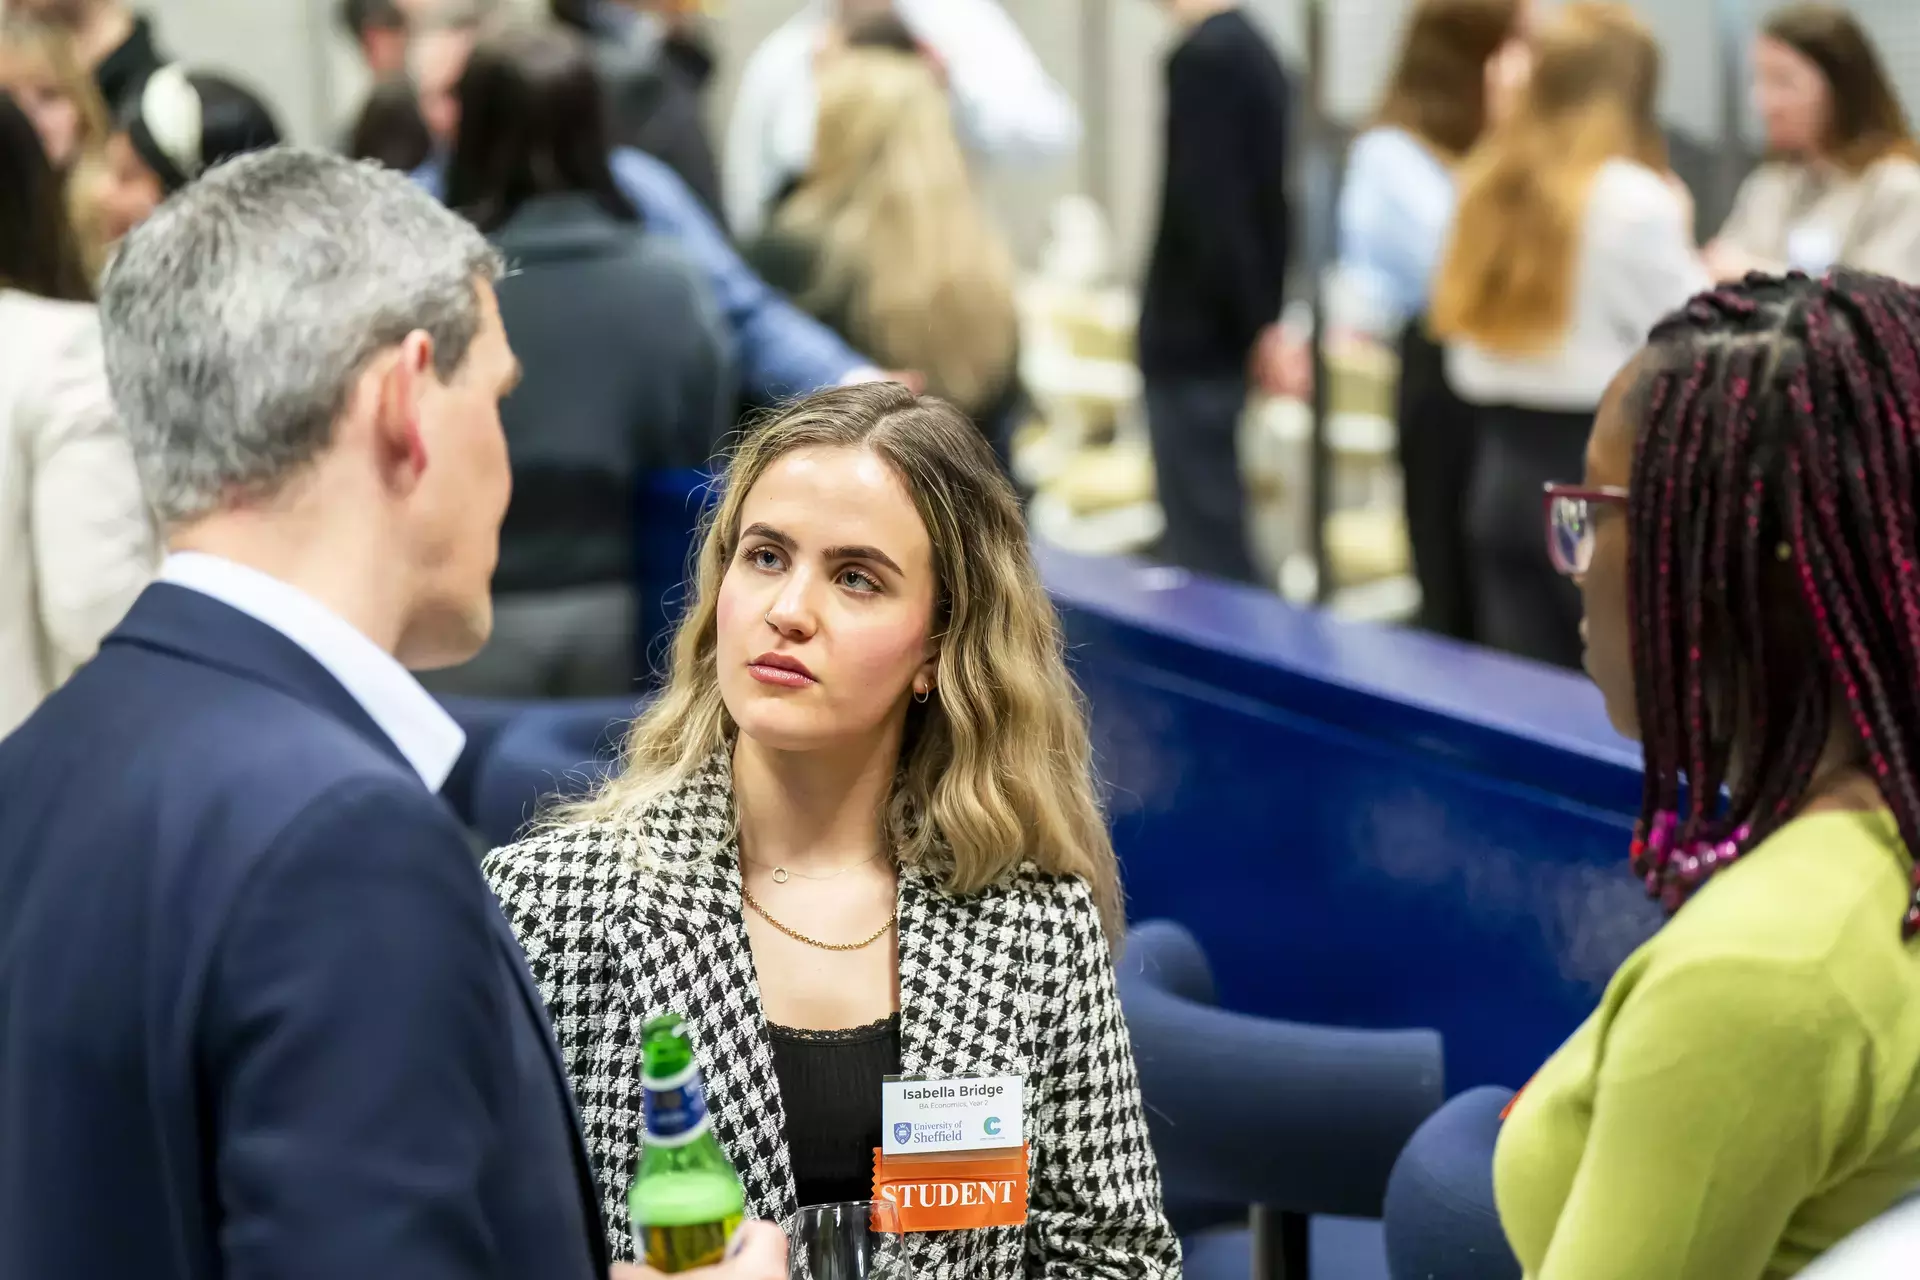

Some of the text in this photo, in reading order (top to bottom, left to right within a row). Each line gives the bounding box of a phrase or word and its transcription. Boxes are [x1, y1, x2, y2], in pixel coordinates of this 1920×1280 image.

[903, 1084, 1004, 1100] Isabella Bridge
[930, 1101, 969, 1109] Economics,
[914, 1120, 962, 1131] University of
[913, 1130, 962, 1143] Sheffield
[881, 1180, 1017, 1208] STUDENT
